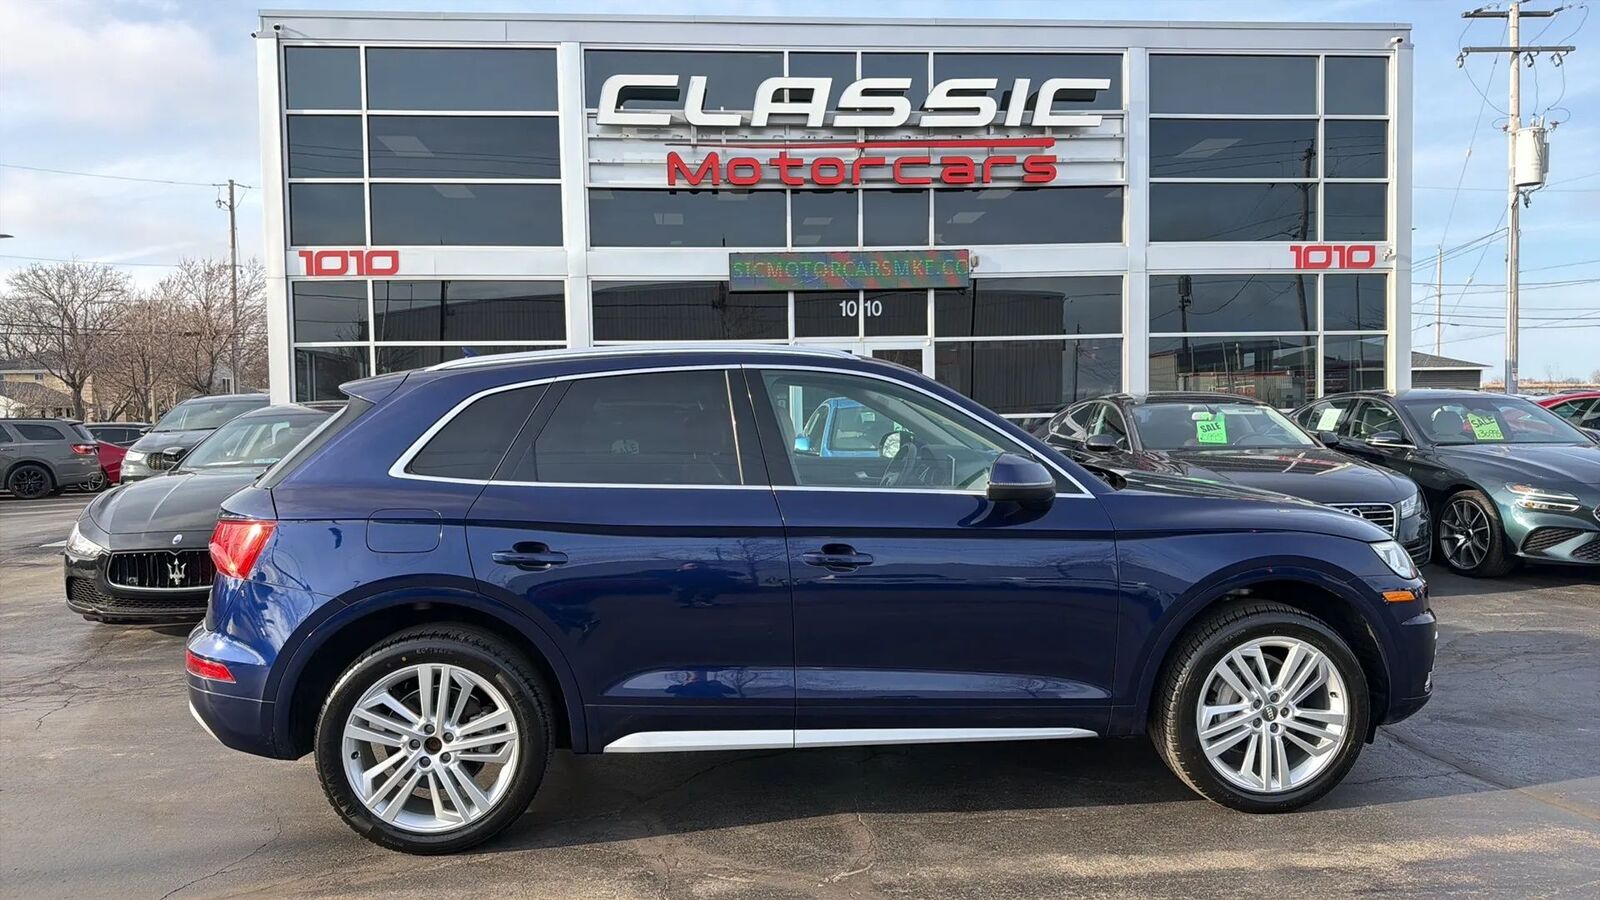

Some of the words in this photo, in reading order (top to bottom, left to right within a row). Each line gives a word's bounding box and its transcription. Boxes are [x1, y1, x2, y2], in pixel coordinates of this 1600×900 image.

[597, 74, 1111, 128] CLASSIC
[667, 150, 1057, 188] Motorcars
[298, 250, 399, 276] 1010
[1290, 245, 1376, 269] 1010
[1200, 422, 1221, 433] SALE
[1471, 415, 1495, 428] SALE
